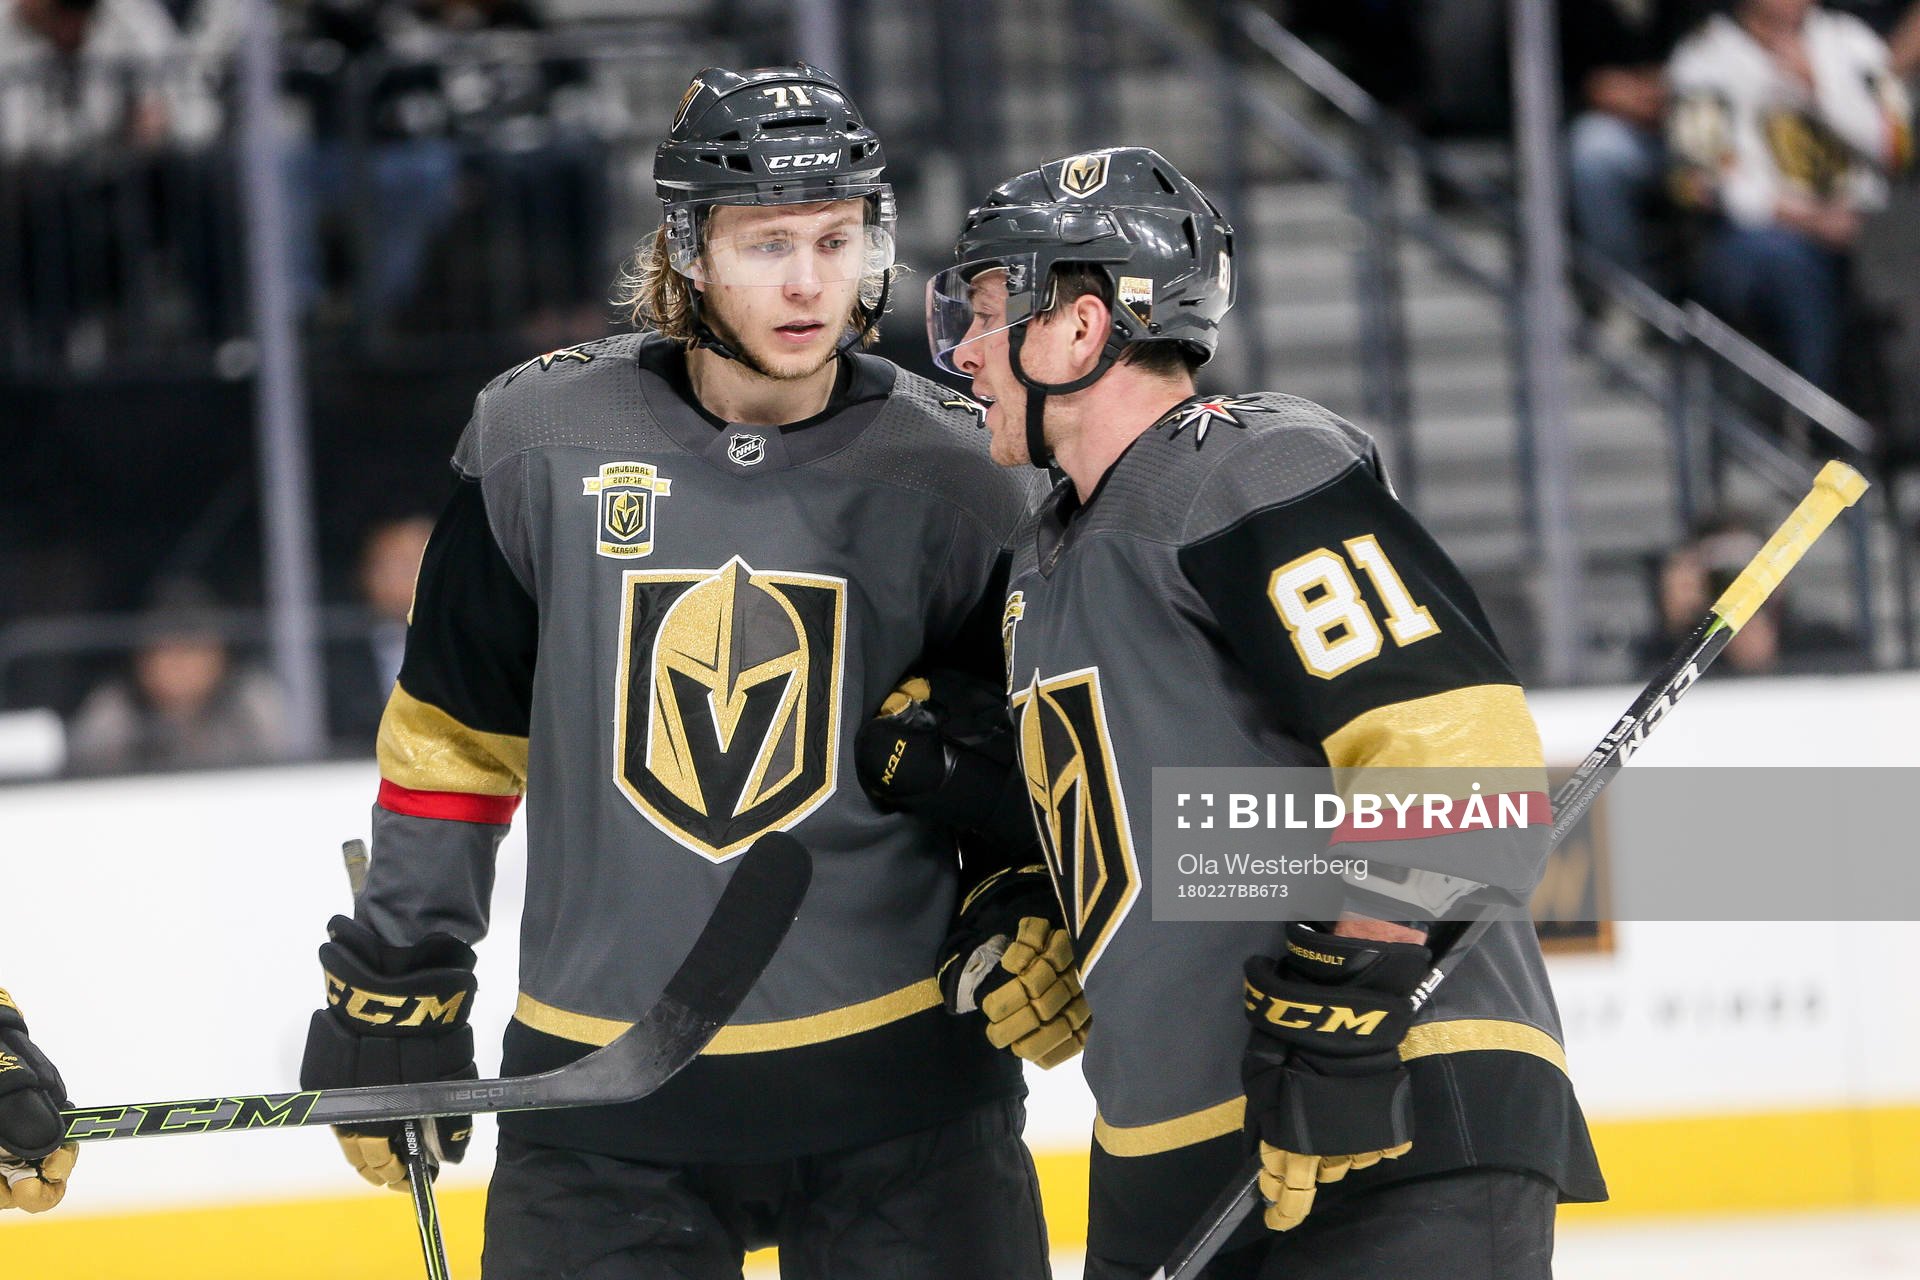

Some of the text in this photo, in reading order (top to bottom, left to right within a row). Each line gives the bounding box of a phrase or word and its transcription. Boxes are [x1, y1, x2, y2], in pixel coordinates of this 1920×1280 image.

[763, 86, 813, 108] 71
[768, 152, 837, 170] CCM
[735, 441, 758, 458] NHL
[606, 465, 650, 476] INAUGURAL
[613, 476, 642, 485] 2017-18
[610, 546, 639, 555] SEASON
[1267, 533, 1442, 680] 81
[1618, 662, 1702, 768] CCM
[325, 970, 467, 1026] CCM
